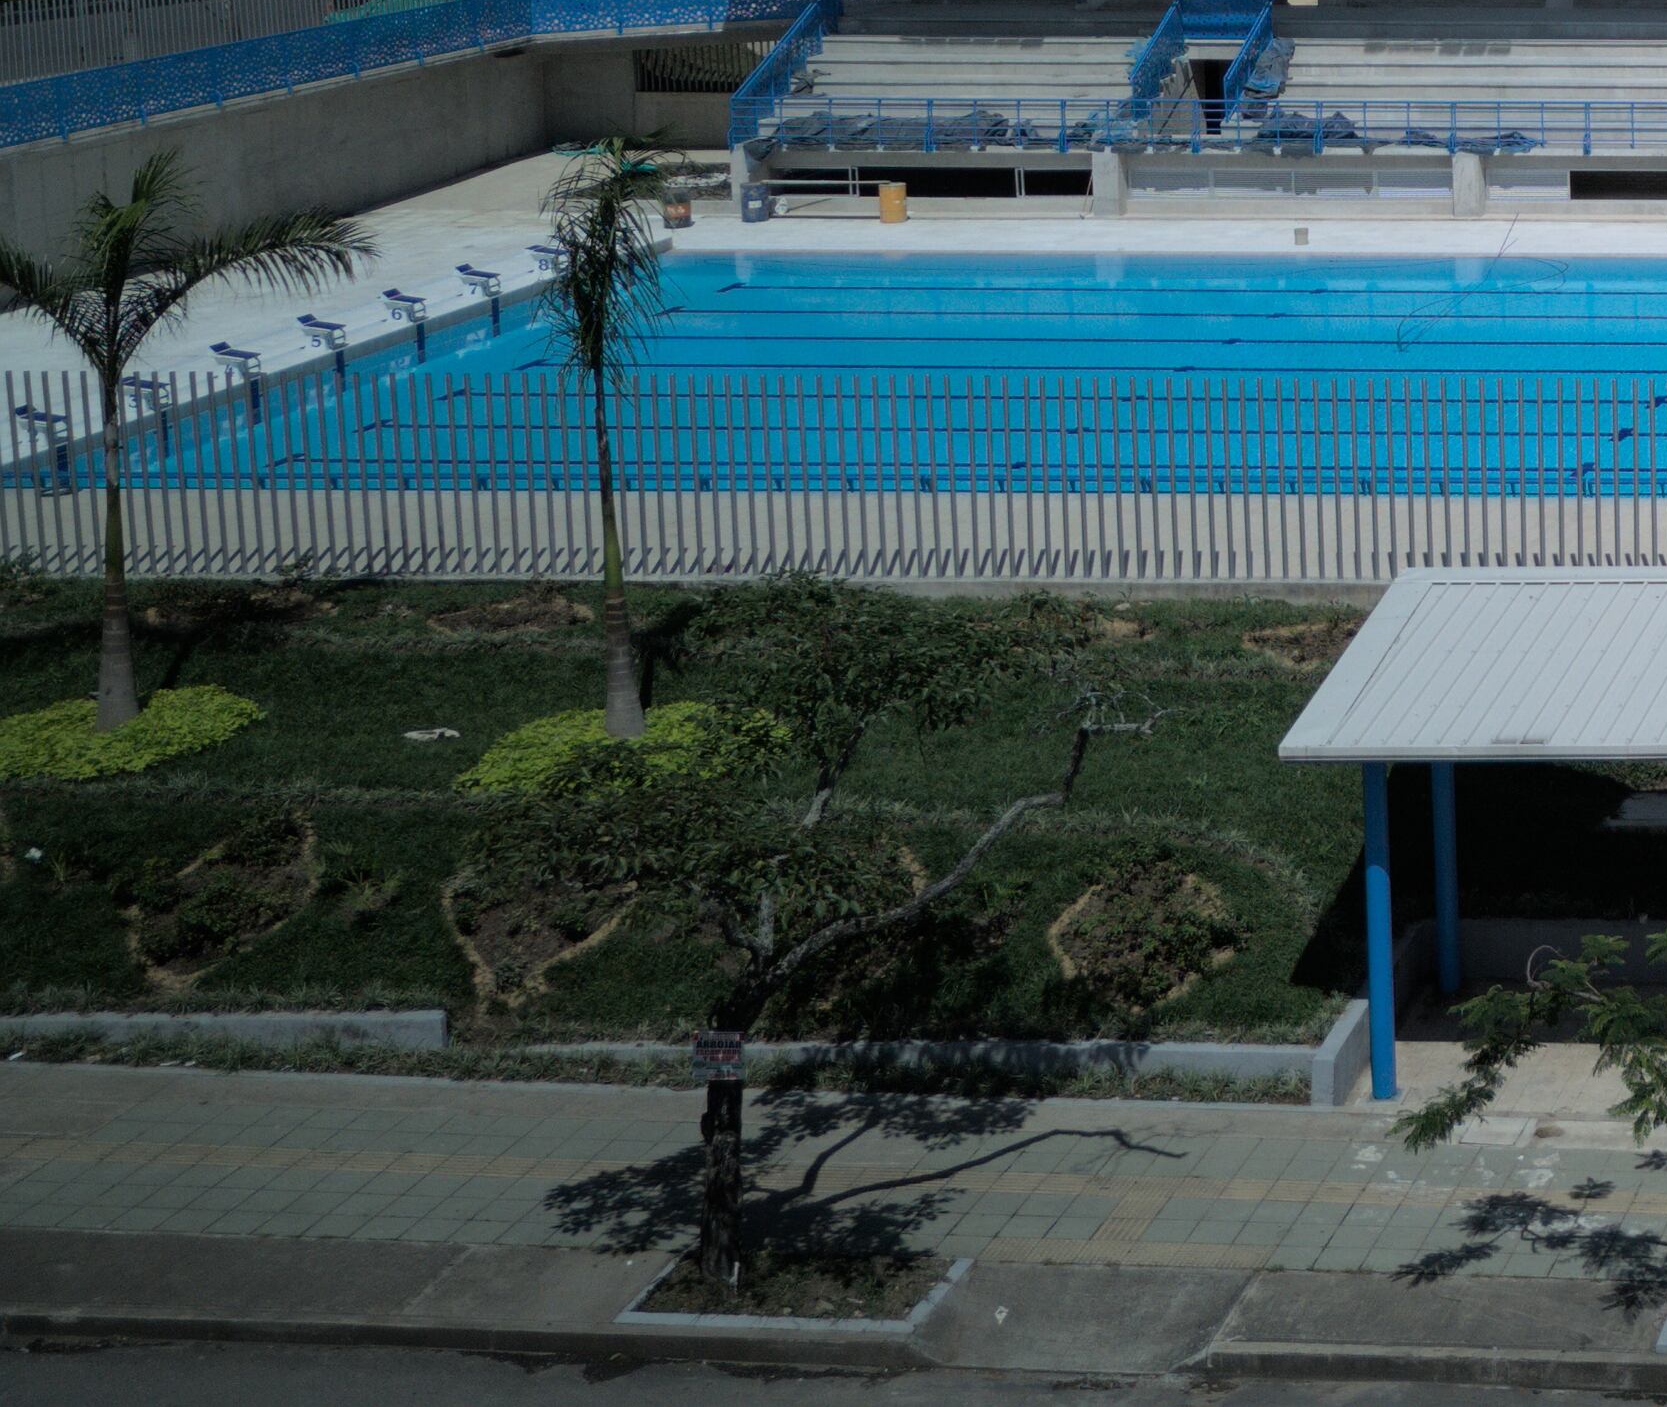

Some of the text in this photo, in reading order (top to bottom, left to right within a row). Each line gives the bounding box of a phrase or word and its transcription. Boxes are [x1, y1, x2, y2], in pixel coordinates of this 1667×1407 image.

[538, 258, 549, 271] 8
[391, 306, 402, 320] 6
[311, 335, 322, 348] 5
